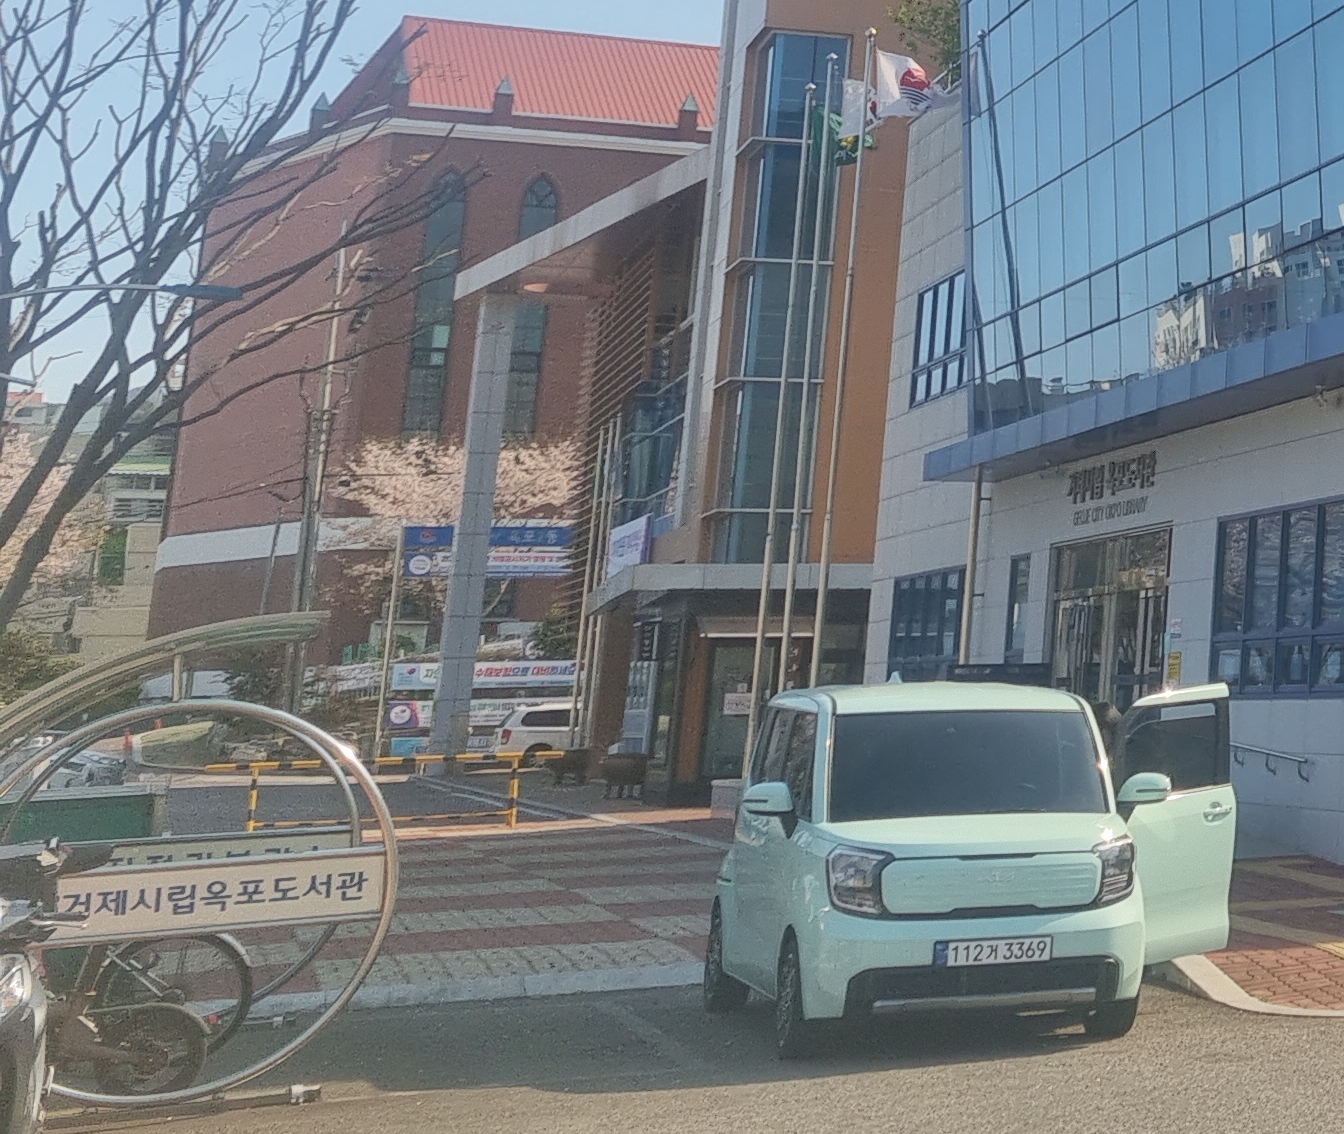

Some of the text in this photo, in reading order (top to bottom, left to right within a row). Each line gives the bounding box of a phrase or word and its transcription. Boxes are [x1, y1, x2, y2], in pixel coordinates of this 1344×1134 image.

[62, 871, 368, 916] 거제시립옥포도서관
[951, 940, 1048, 964] 112거 3369
